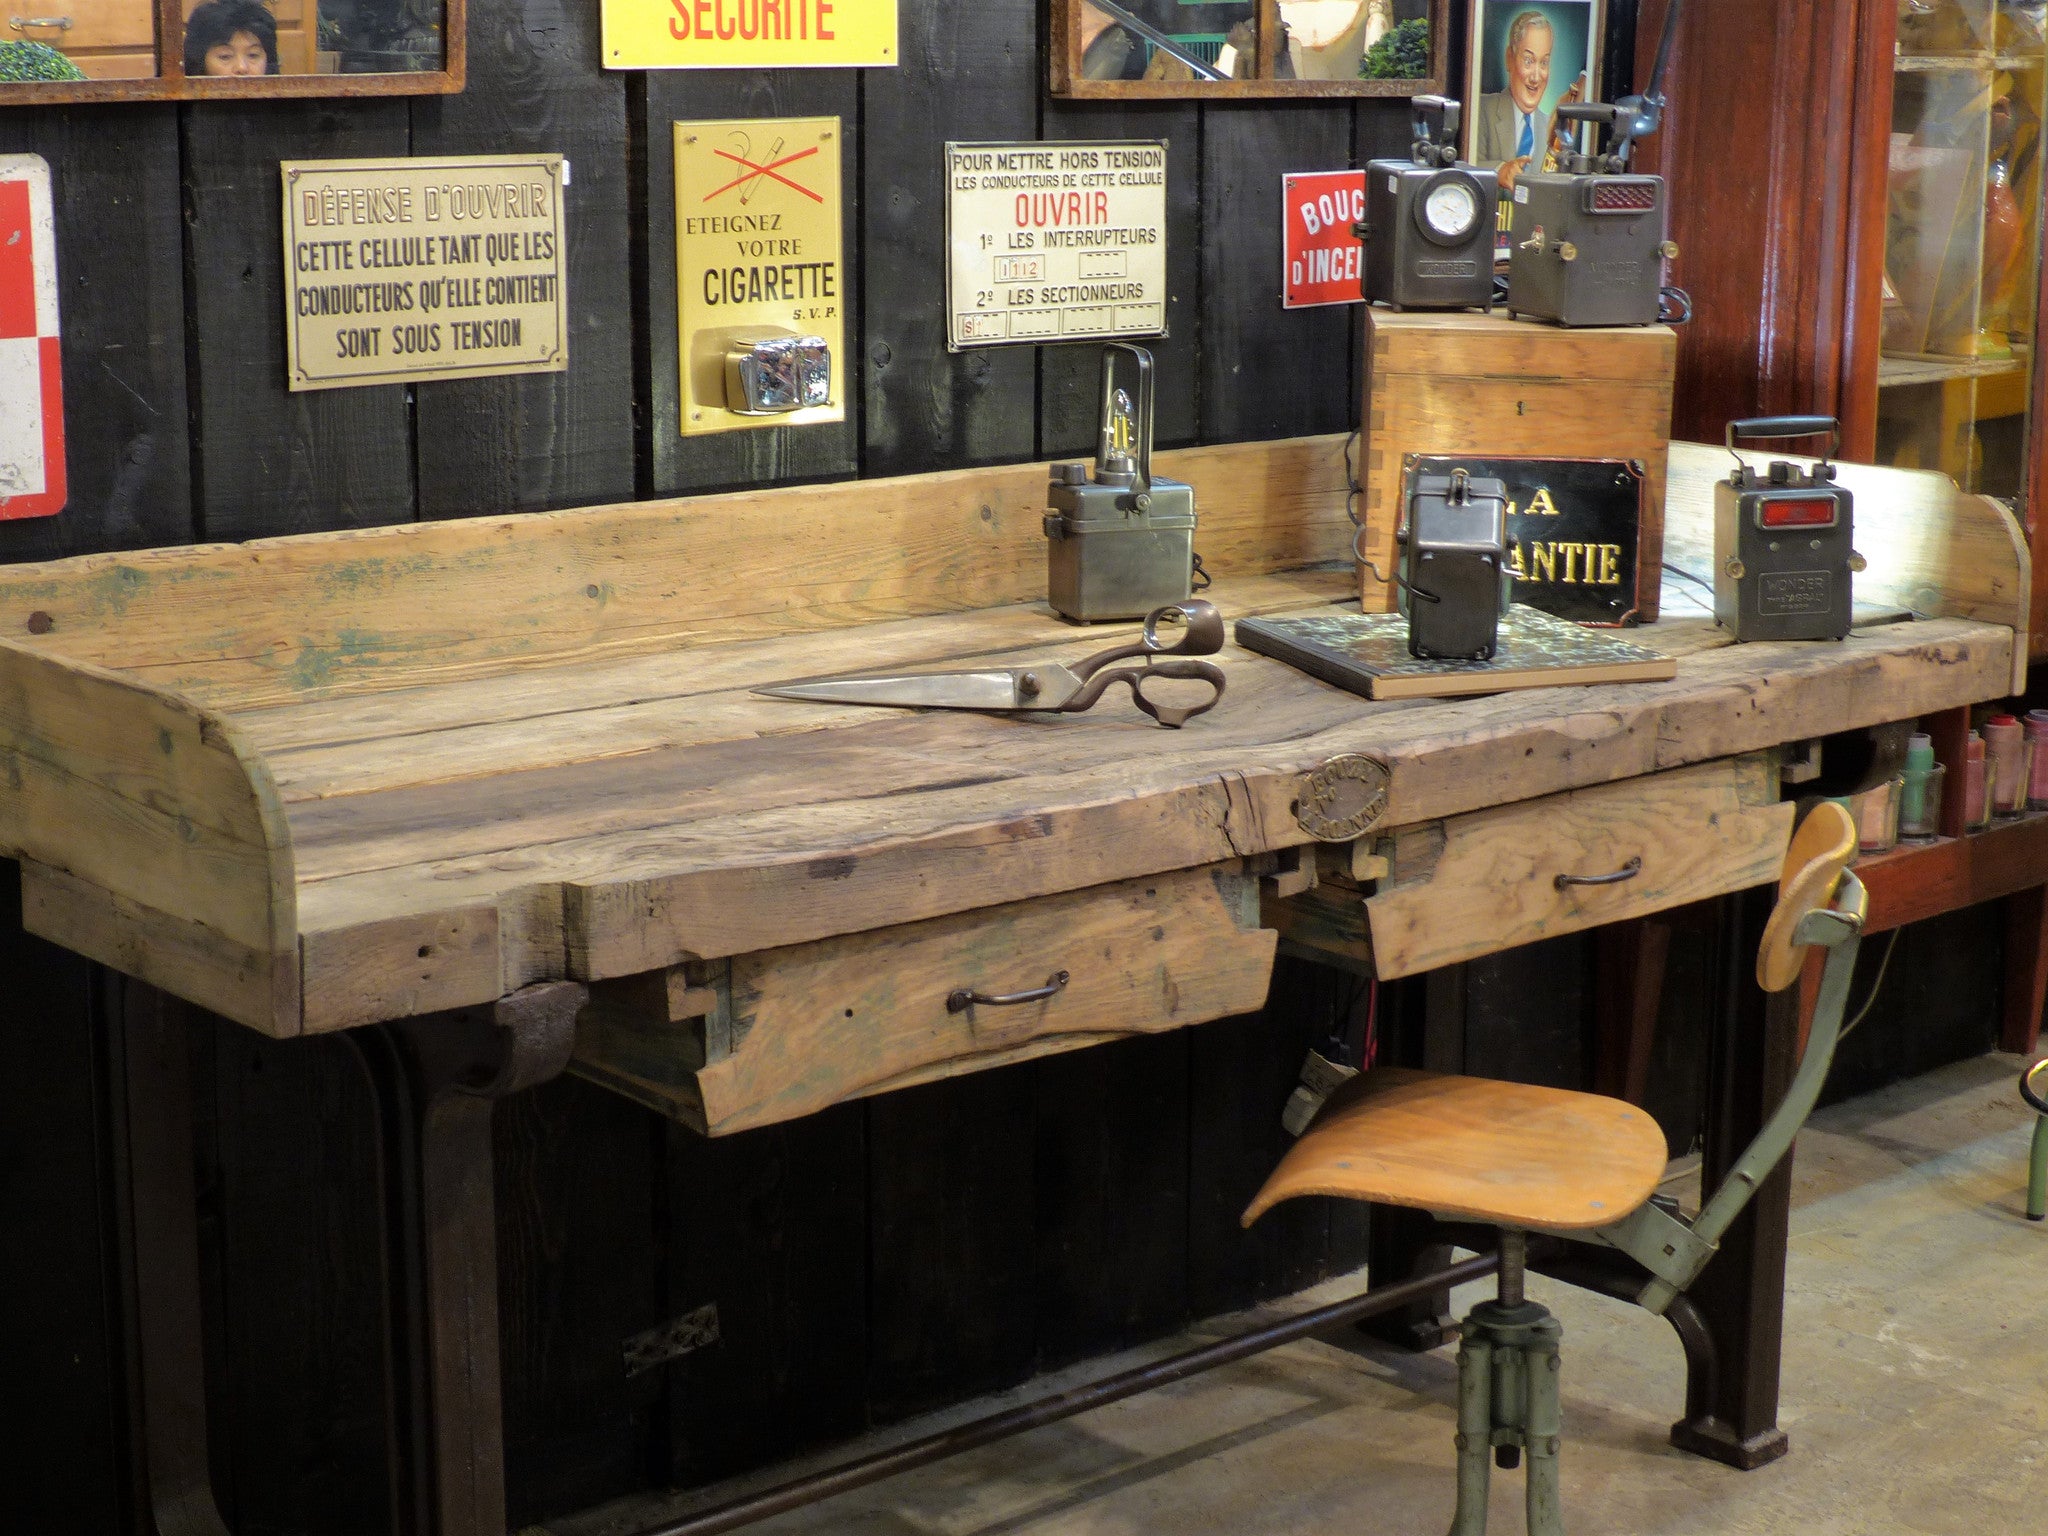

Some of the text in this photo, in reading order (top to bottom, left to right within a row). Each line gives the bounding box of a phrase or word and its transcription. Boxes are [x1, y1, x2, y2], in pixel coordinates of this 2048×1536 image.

[953, 150, 1162, 171] POUR METTRE HORS TENSION
[955, 172, 1163, 190] LES CONDUCTEURS DE CETTE CELLULE
[303, 182, 548, 227] DÉFENSE D'OUVRIR
[1015, 190, 1108, 228] OUVRIR
[686, 213, 782, 235] ETEIGNEZ
[297, 230, 554, 272] CETTE CELLULE TANT QUE LES
[737, 239, 802, 257] VOTRE
[1008, 232, 1034, 249] LES
[1044, 228, 1157, 247] INTERRUPTEURS
[298, 273, 557, 316] CONDUCTEURS QU'ELLE CONTIENT
[703, 261, 835, 306] CIGARETTE
[1008, 288, 1034, 306] LES
[1042, 282, 1144, 303] SECTIONNEURS
[336, 317, 522, 358] SONT SOUS TENSION
[1506, 488, 1561, 516] A
